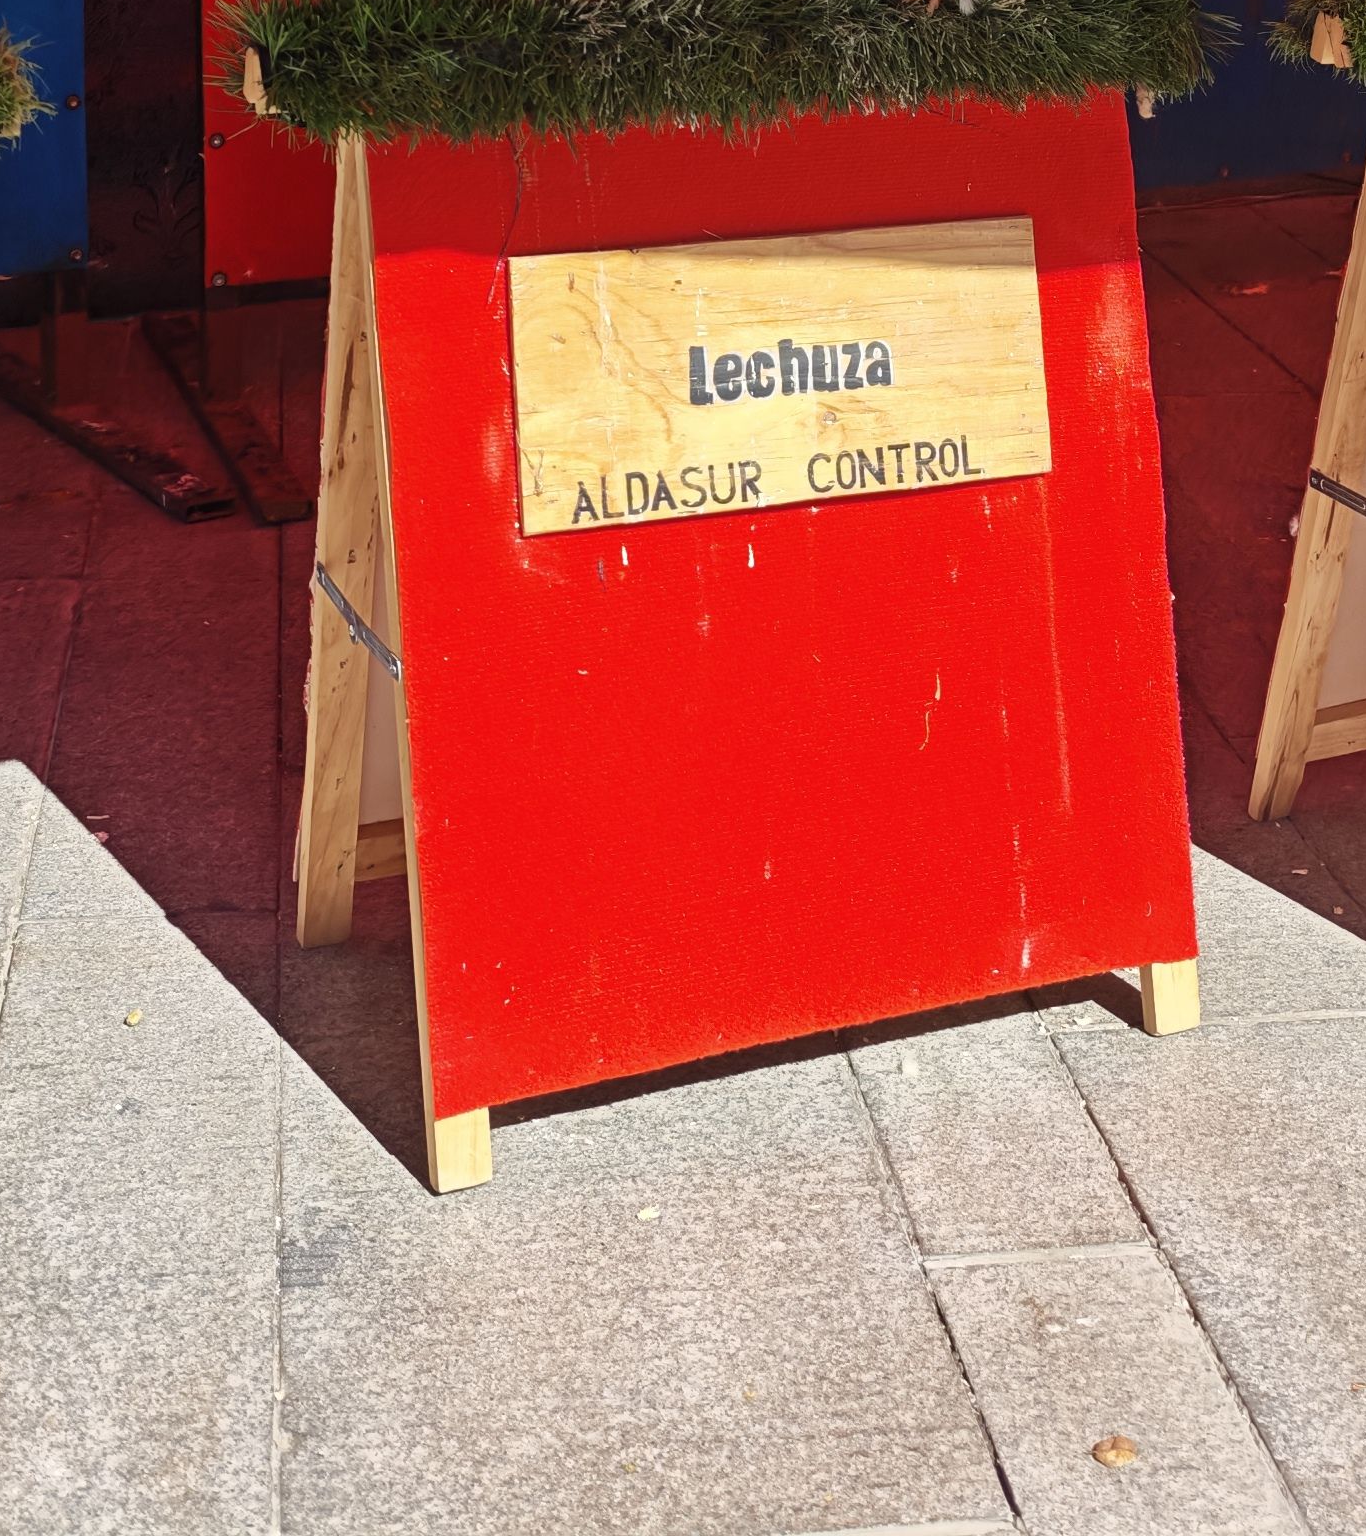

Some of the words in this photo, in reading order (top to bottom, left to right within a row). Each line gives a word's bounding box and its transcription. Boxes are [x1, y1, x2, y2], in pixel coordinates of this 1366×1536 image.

[688, 338, 892, 405] Lechuza
[571, 460, 762, 524] ALDASUR
[807, 435, 983, 493] CONTROL
